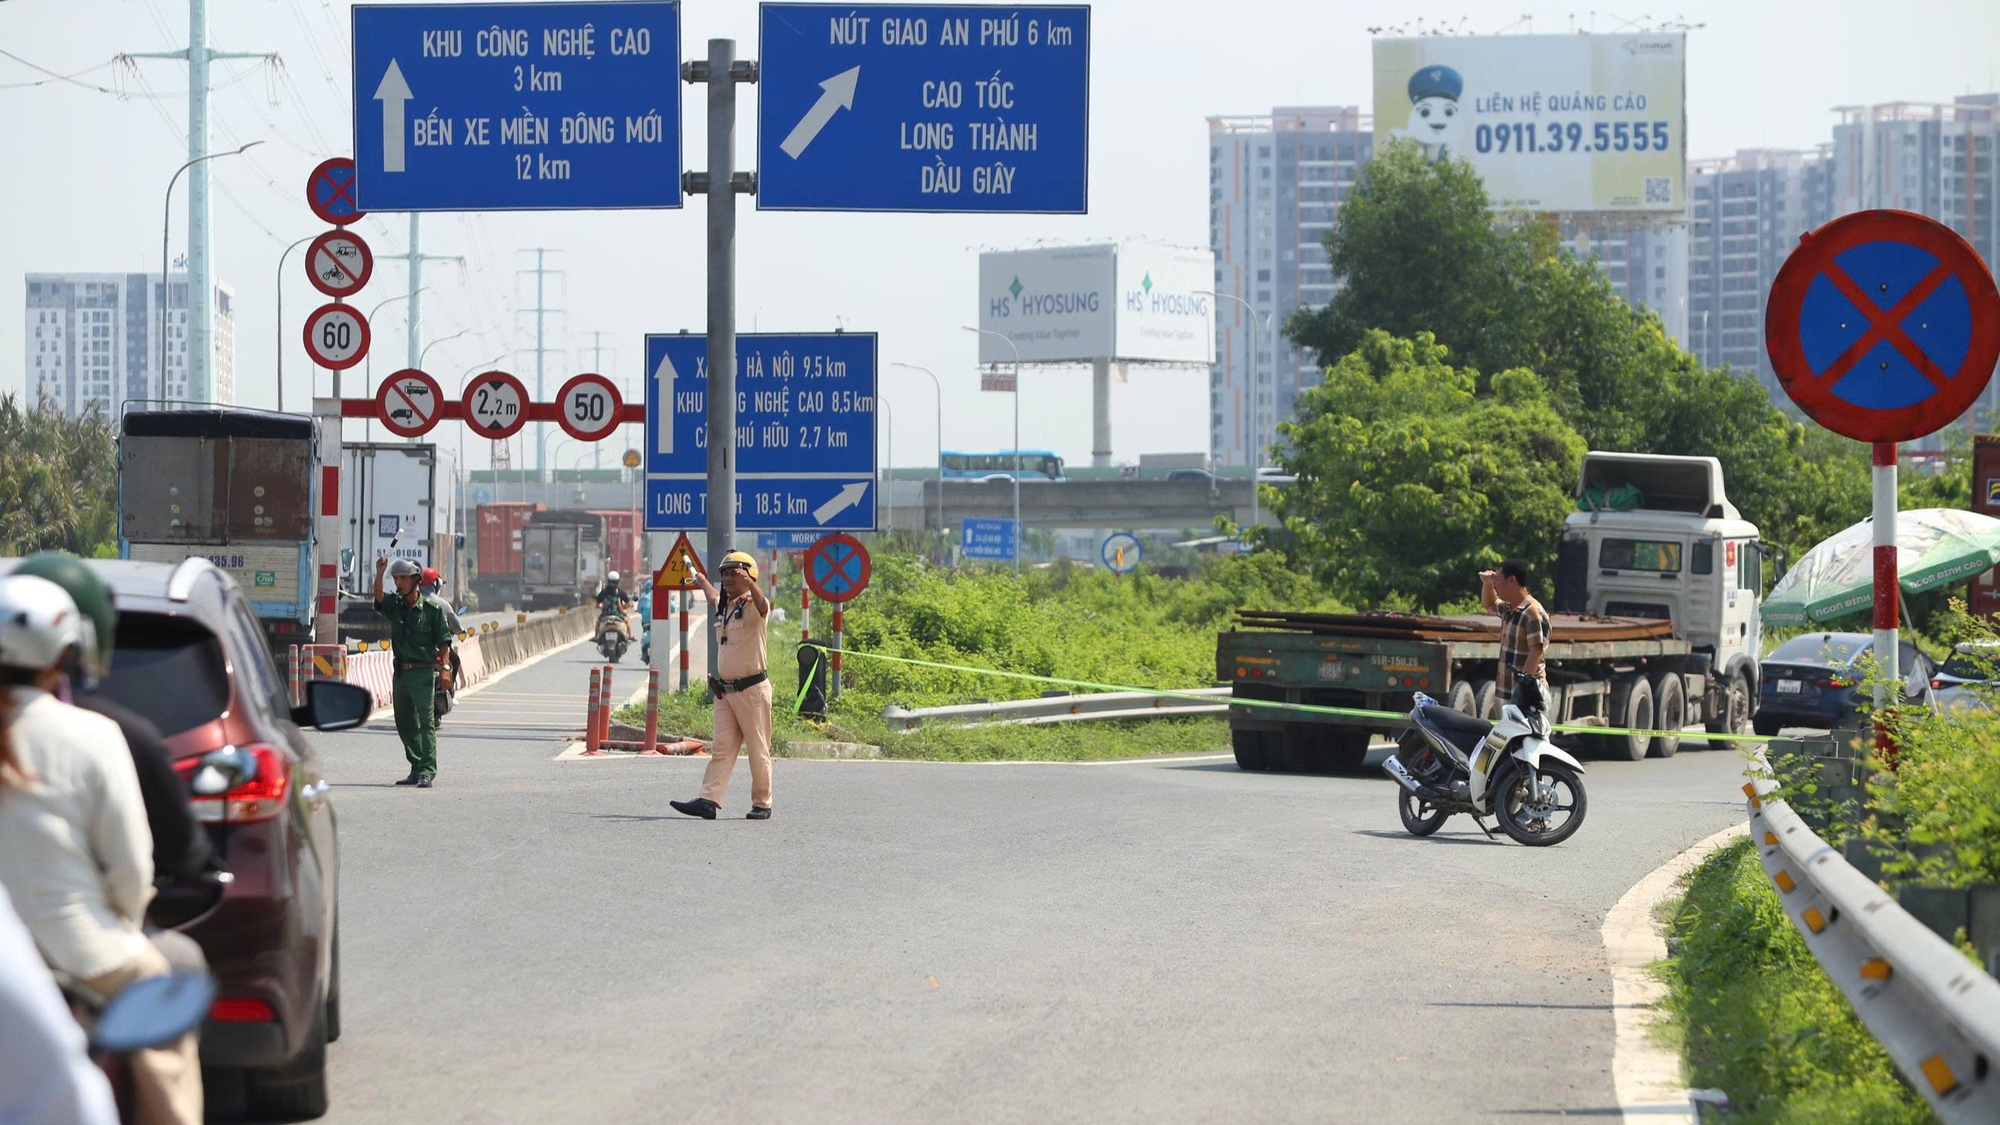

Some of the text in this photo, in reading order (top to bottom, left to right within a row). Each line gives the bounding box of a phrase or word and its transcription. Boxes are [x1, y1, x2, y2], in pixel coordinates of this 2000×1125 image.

[423, 23, 650, 60] KHU CÔNG NGHỆ CAO
[830, 10, 1072, 46] NÚT GIAO AN PHÚ 6 km
[514, 64, 562, 92] 3 km
[922, 70, 1014, 108] CAO TỐC
[1476, 94, 1514, 113] LIÊN
[1521, 91, 1542, 116] HỆ
[414, 106, 662, 146] BẾN XE MIỀN ĐÔNG MỚI
[900, 116, 1037, 150] LONG THÀNH
[1476, 121, 1669, 153] 0911.39.5555
[516, 153, 570, 180] 12 km
[922, 154, 1016, 194] DẦU GIÂY
[991, 292, 1099, 317] HS HYOSUNG
[1127, 291, 1206, 316] HS HYOSUNG
[323, 322, 350, 350] 60
[746, 351, 764, 378] HÀ
[773, 350, 794, 381] NỘI
[803, 356, 822, 379] 9,5
[826, 356, 846, 377] km
[574, 393, 604, 421] 50
[677, 392, 702, 413] KHU
[755, 386, 789, 417] NGHỆ
[798, 392, 824, 412] CAO
[832, 391, 850, 414] 8,5
[854, 391, 874, 413] km
[735, 421, 754, 448] HÚ
[763, 421, 789, 448] HỮU
[800, 426, 822, 448] 2,7
[828, 426, 848, 448] km
[657, 493, 692, 514] LONG
[755, 493, 781, 516] 18,5
[788, 493, 807, 514] km
